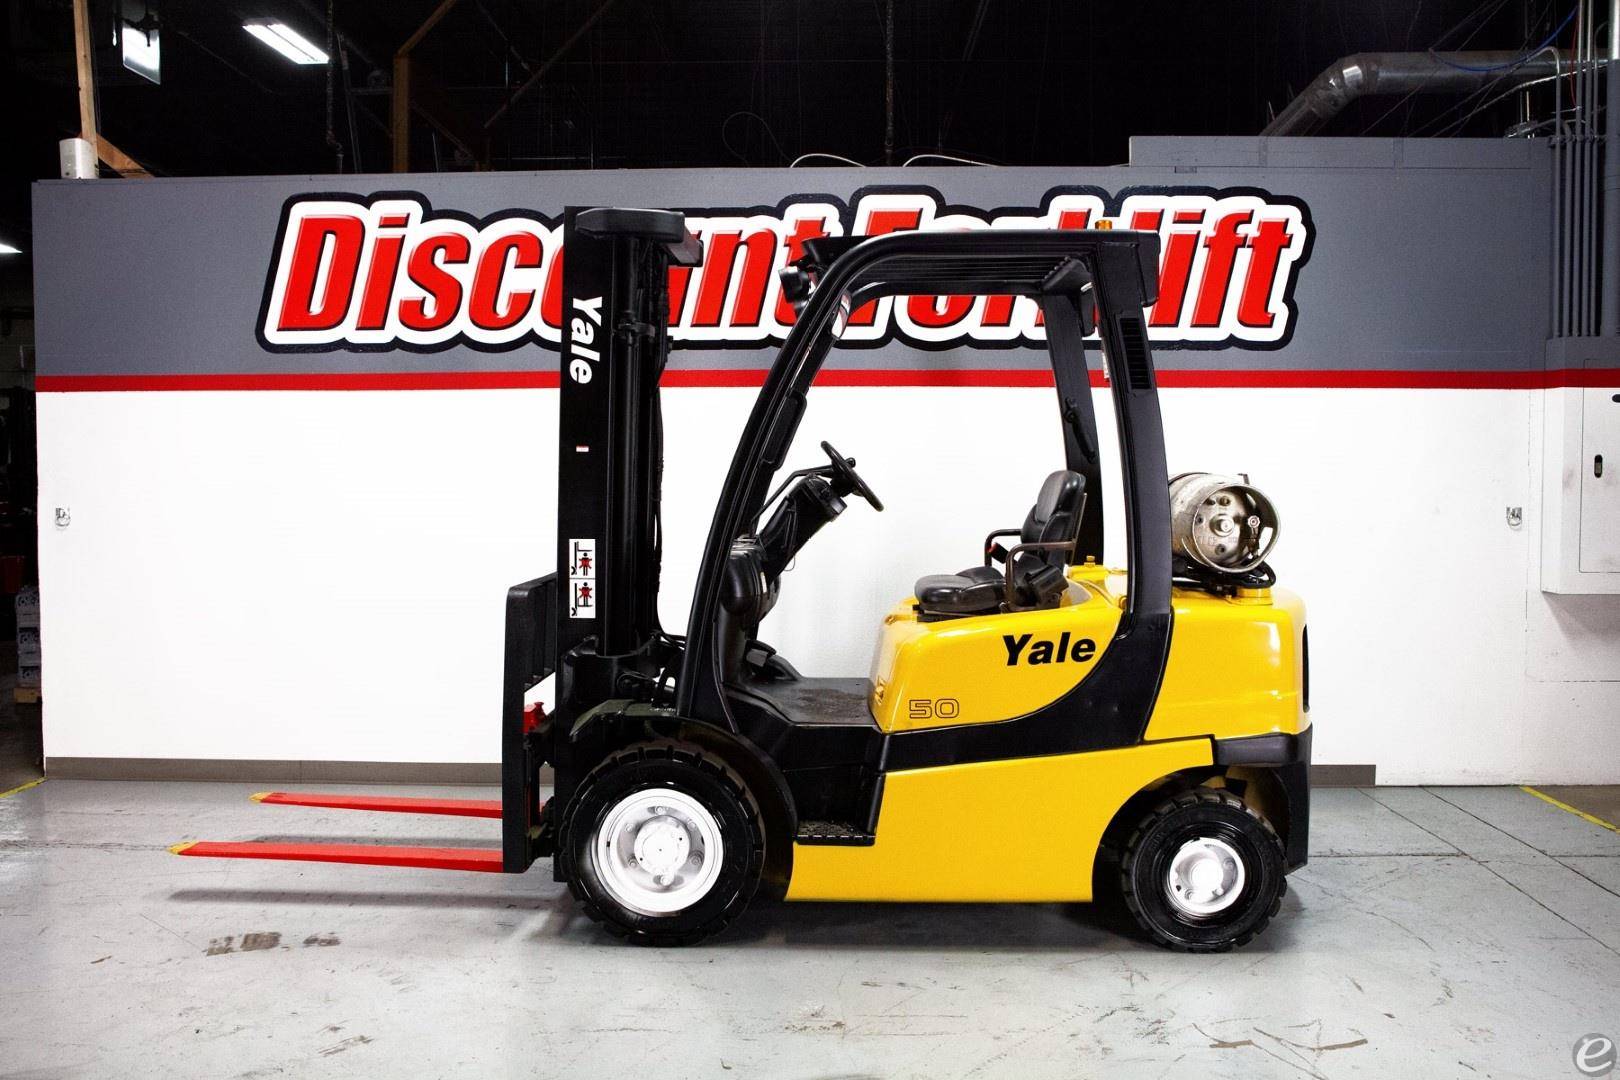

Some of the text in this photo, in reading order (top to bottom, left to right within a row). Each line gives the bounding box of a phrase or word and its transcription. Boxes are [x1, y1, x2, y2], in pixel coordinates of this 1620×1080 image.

[570, 296, 603, 384] Yale
[1003, 631, 1096, 667] Yale
[909, 698, 960, 719] 50
